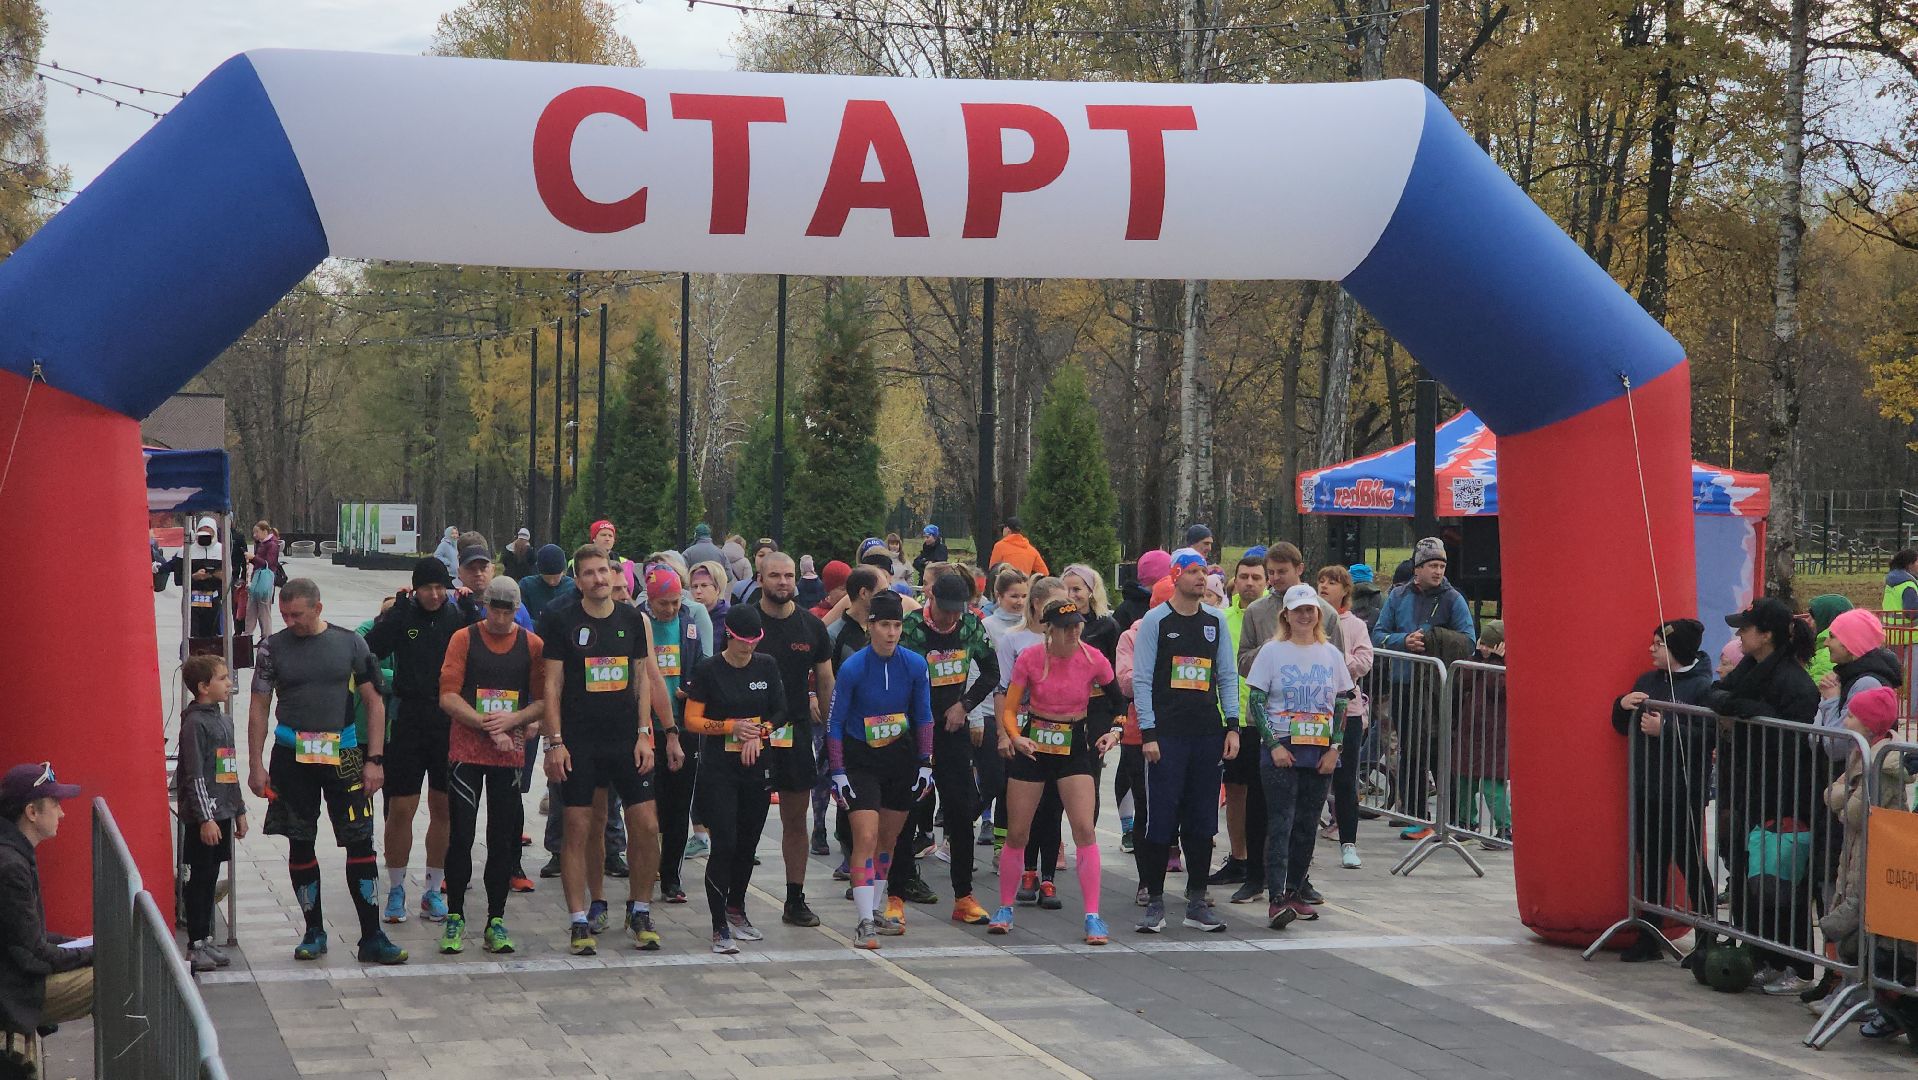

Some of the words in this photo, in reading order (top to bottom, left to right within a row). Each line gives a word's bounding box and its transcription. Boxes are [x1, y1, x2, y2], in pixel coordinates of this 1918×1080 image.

[532, 84, 1198, 241] СТАРТ
[1333, 478, 1395, 510] redBike
[590, 666, 624, 681] 140
[934, 660, 963, 677] 156
[1176, 665, 1207, 681] 102
[481, 699, 513, 713] 103
[871, 723, 902, 740] 139
[1036, 729, 1065, 745] 110
[1297, 722, 1324, 736] 157
[301, 740, 334, 756] 154
